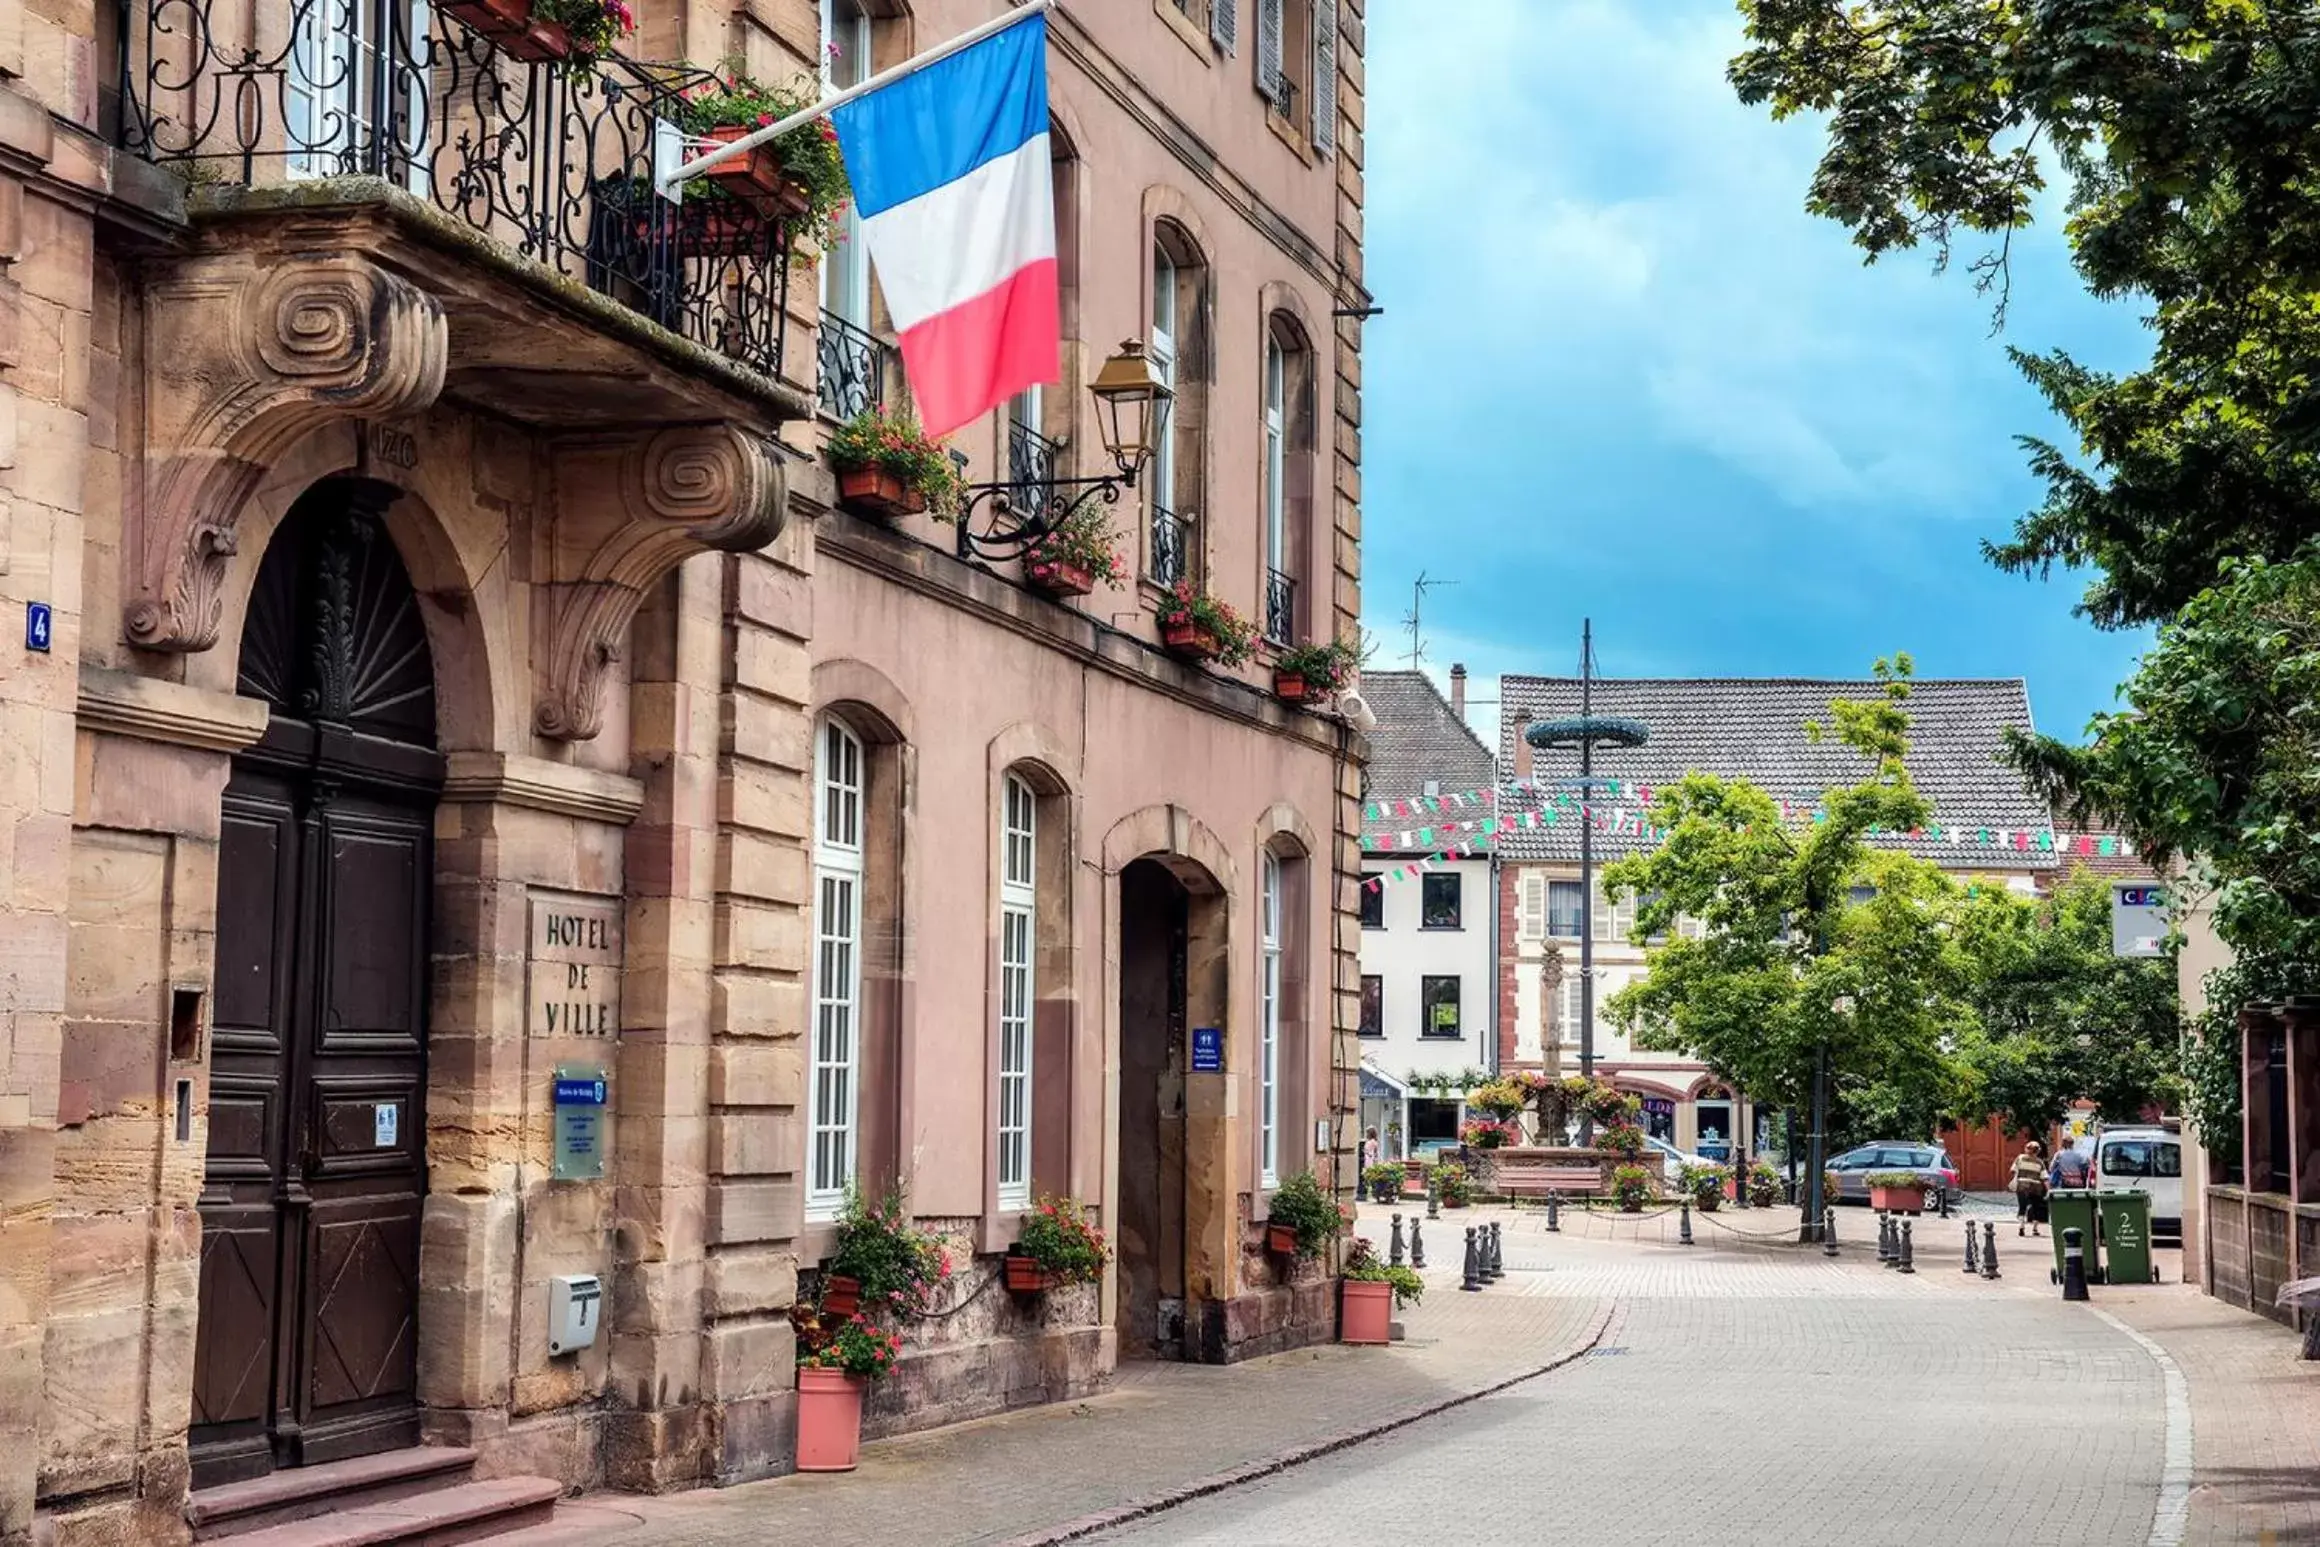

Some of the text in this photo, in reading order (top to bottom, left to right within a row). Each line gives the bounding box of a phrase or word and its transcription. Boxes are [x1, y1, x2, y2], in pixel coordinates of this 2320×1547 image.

[35, 612, 47, 642] 4
[546, 914, 609, 950] HOTEL
[568, 962, 589, 990] DE
[546, 1001, 608, 1035] VILLE
[2120, 1212, 2131, 1228] 2
